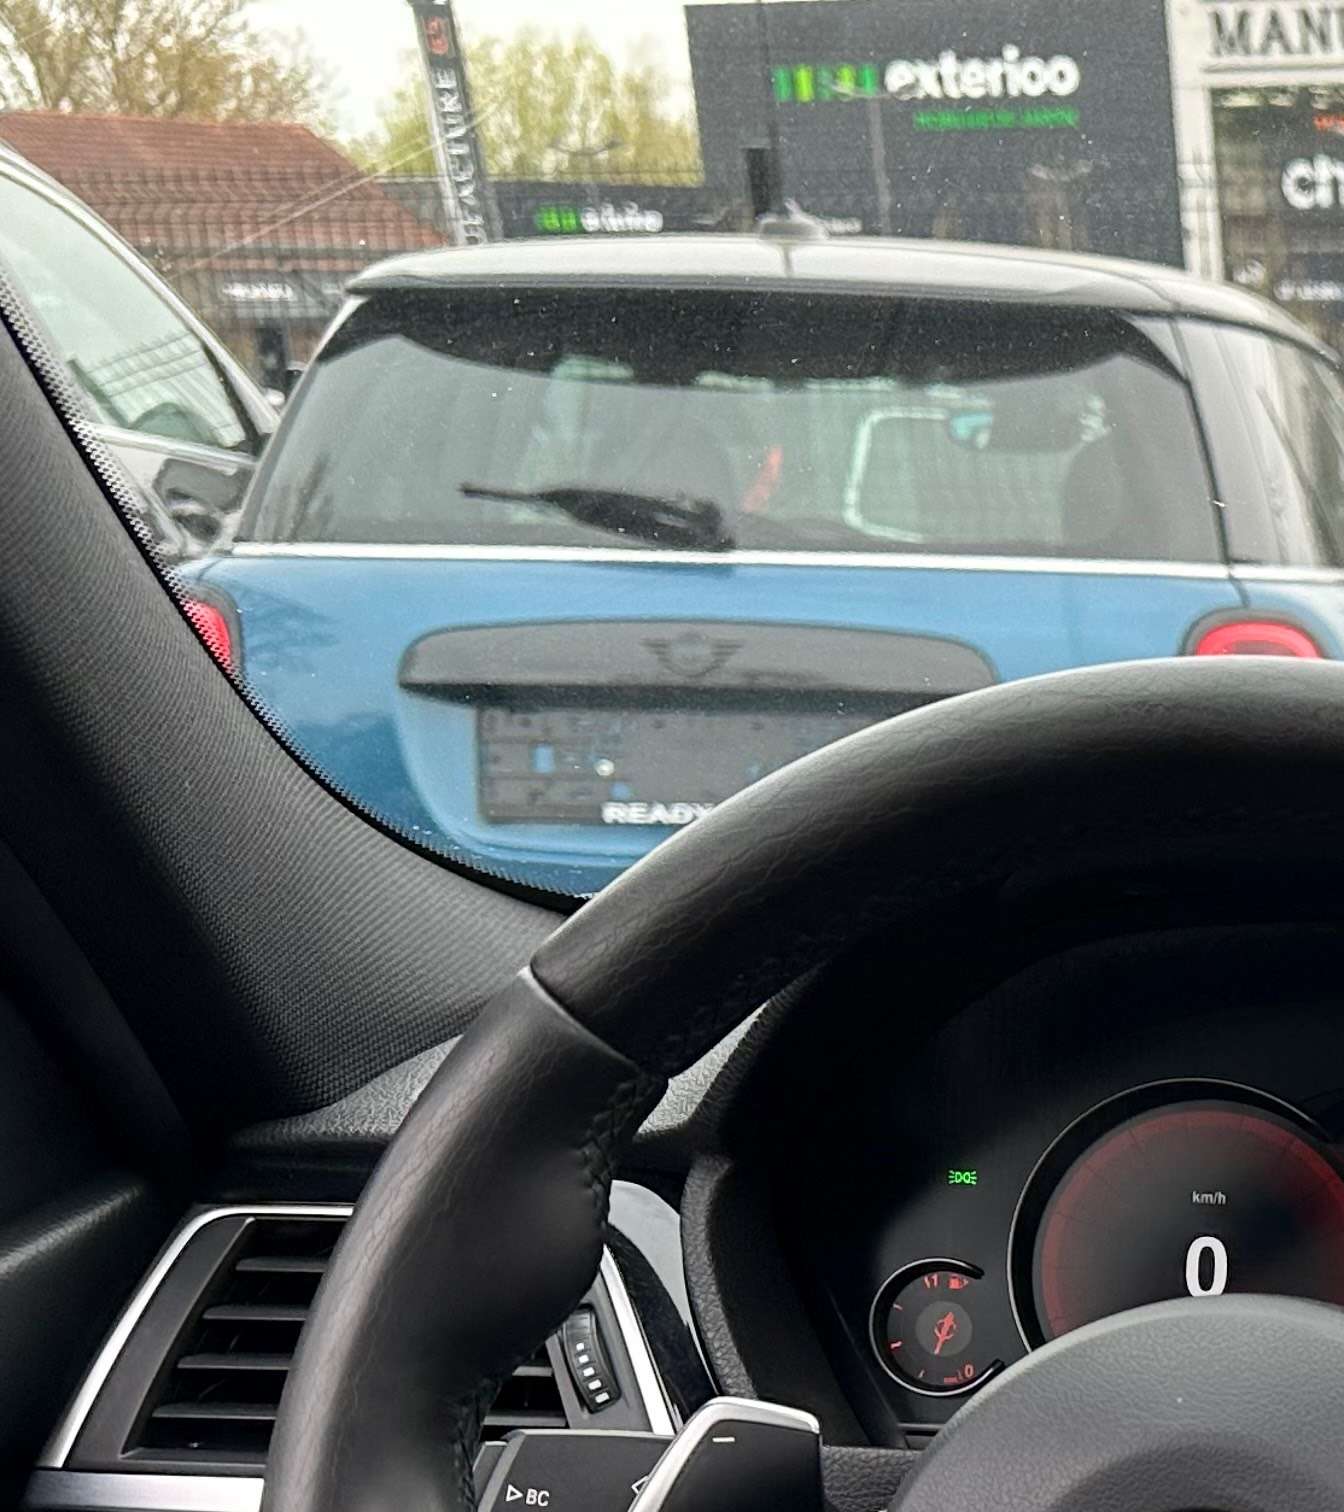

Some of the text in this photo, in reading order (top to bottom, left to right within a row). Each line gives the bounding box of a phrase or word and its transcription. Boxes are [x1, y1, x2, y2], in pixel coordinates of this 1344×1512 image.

[884, 44, 1080, 99] exterioo
[1192, 1190, 1227, 1206] km/h
[1185, 1236, 1228, 1297] 0
[526, 1487, 550, 1508] BC
